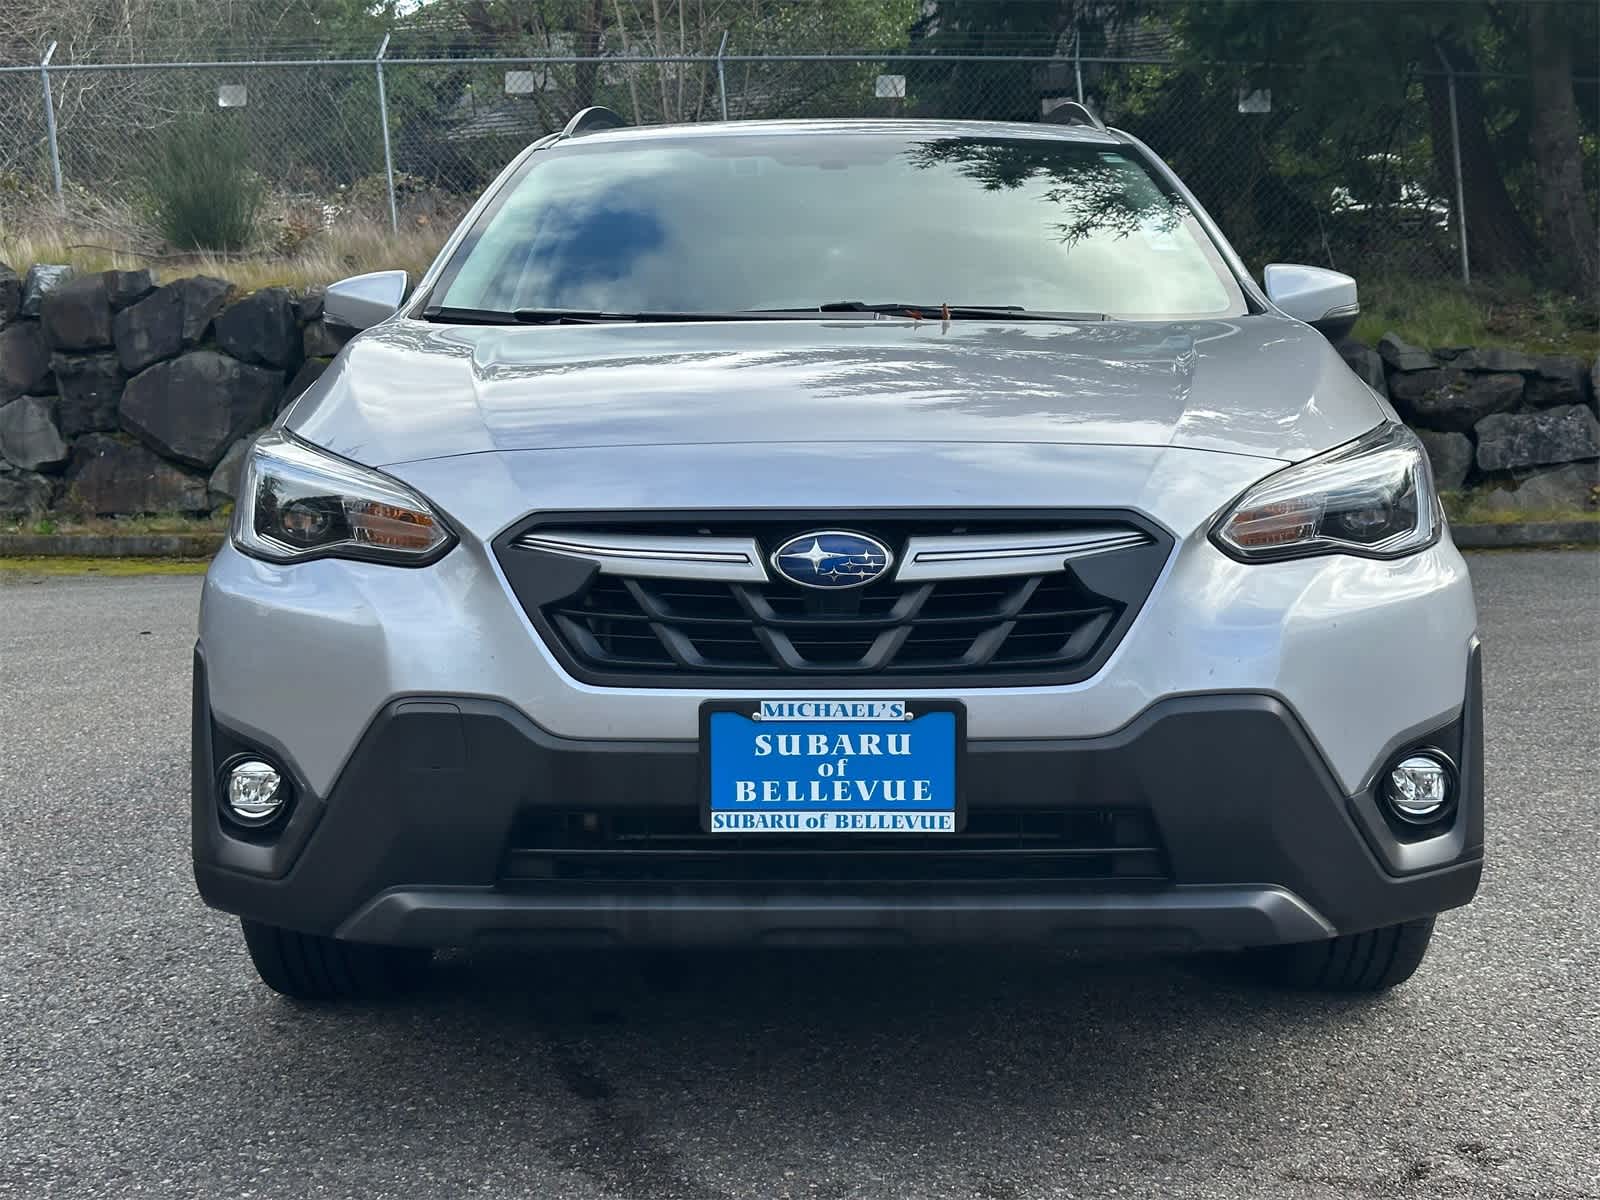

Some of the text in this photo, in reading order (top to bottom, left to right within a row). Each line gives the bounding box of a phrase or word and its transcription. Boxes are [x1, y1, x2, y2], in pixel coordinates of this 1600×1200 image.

[762, 703, 904, 718] MICHAEL'S
[754, 733, 912, 756] SUBARU
[817, 758, 849, 777] of
[735, 780, 932, 802] BELLEVUE
[713, 813, 952, 830] SUBARU of BELLEVUE
